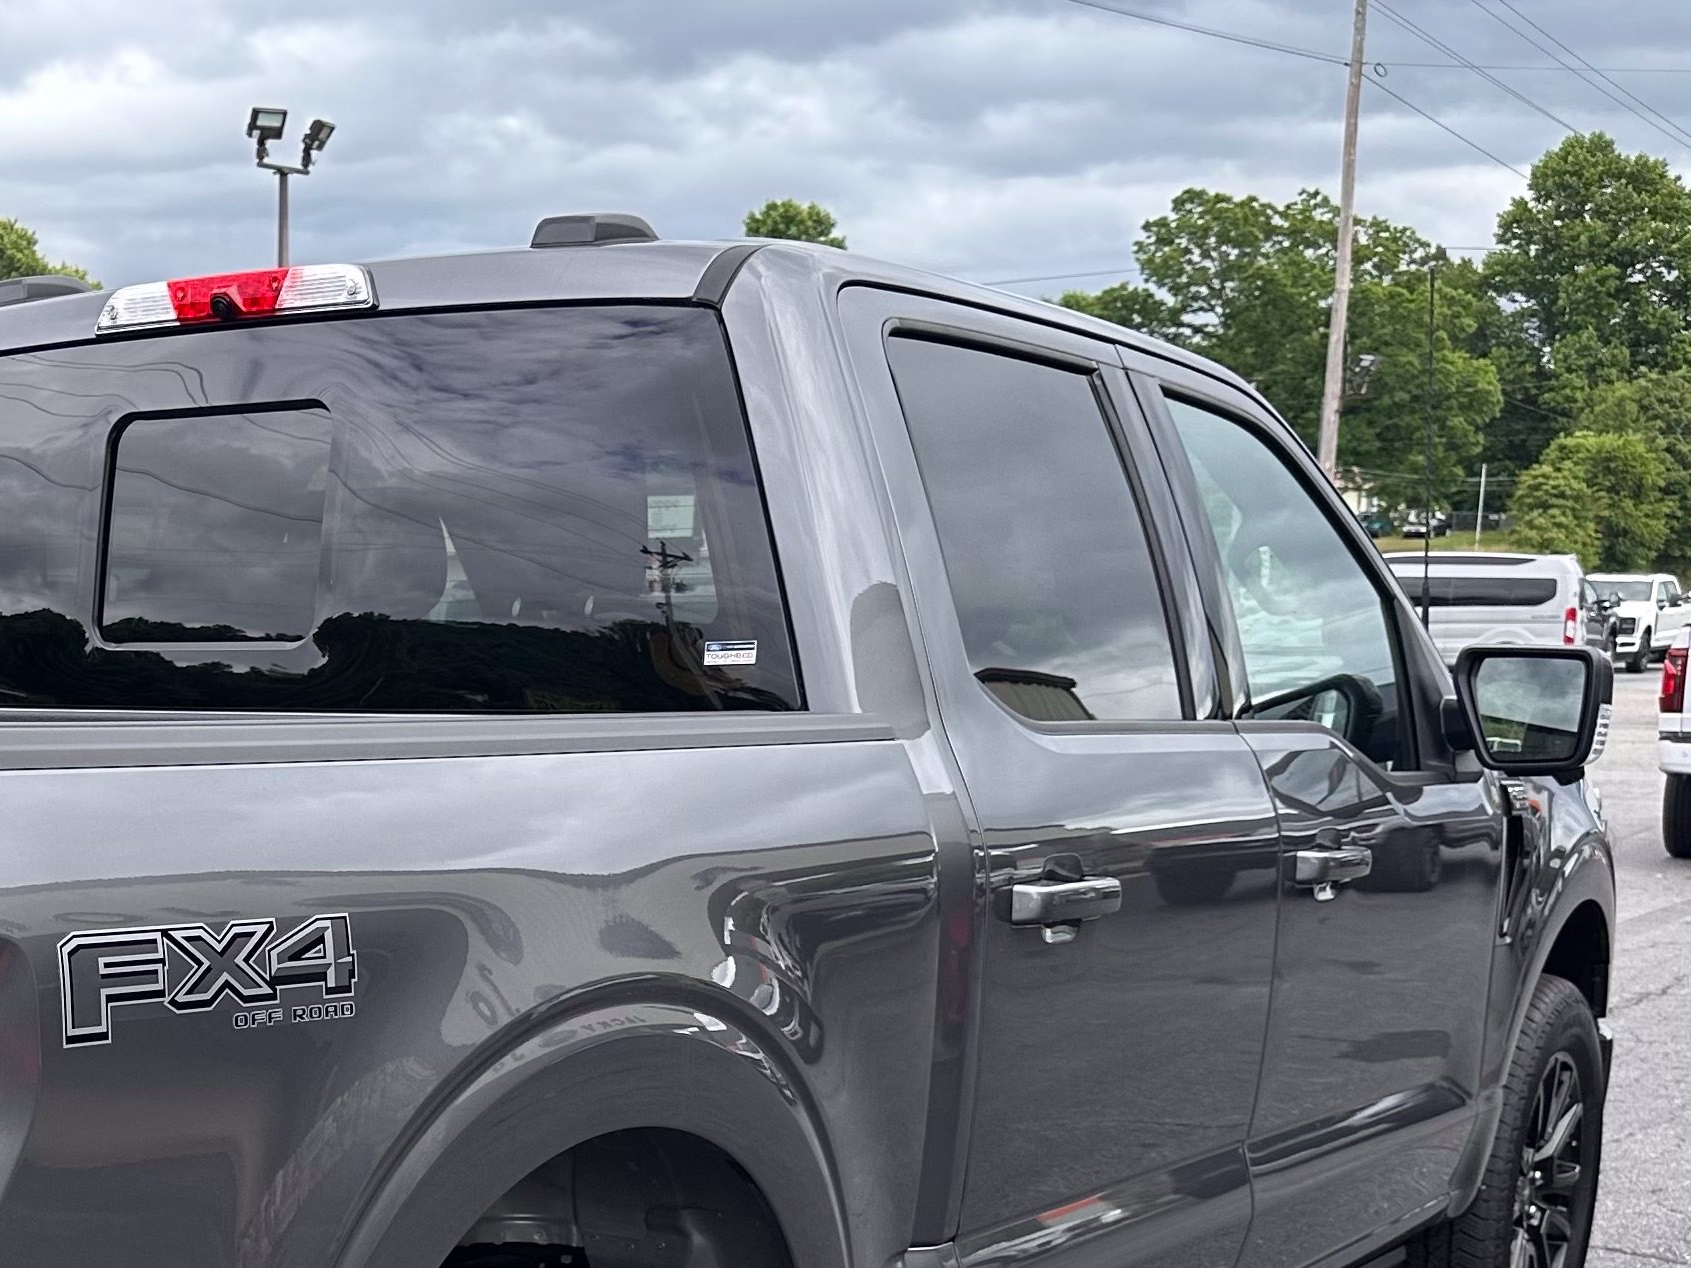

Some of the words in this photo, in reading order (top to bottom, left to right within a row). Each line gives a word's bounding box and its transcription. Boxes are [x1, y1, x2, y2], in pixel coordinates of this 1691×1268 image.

[56, 912, 358, 1049] FX4
[233, 1008, 284, 1030] OFF
[291, 1001, 357, 1024] ROAD
